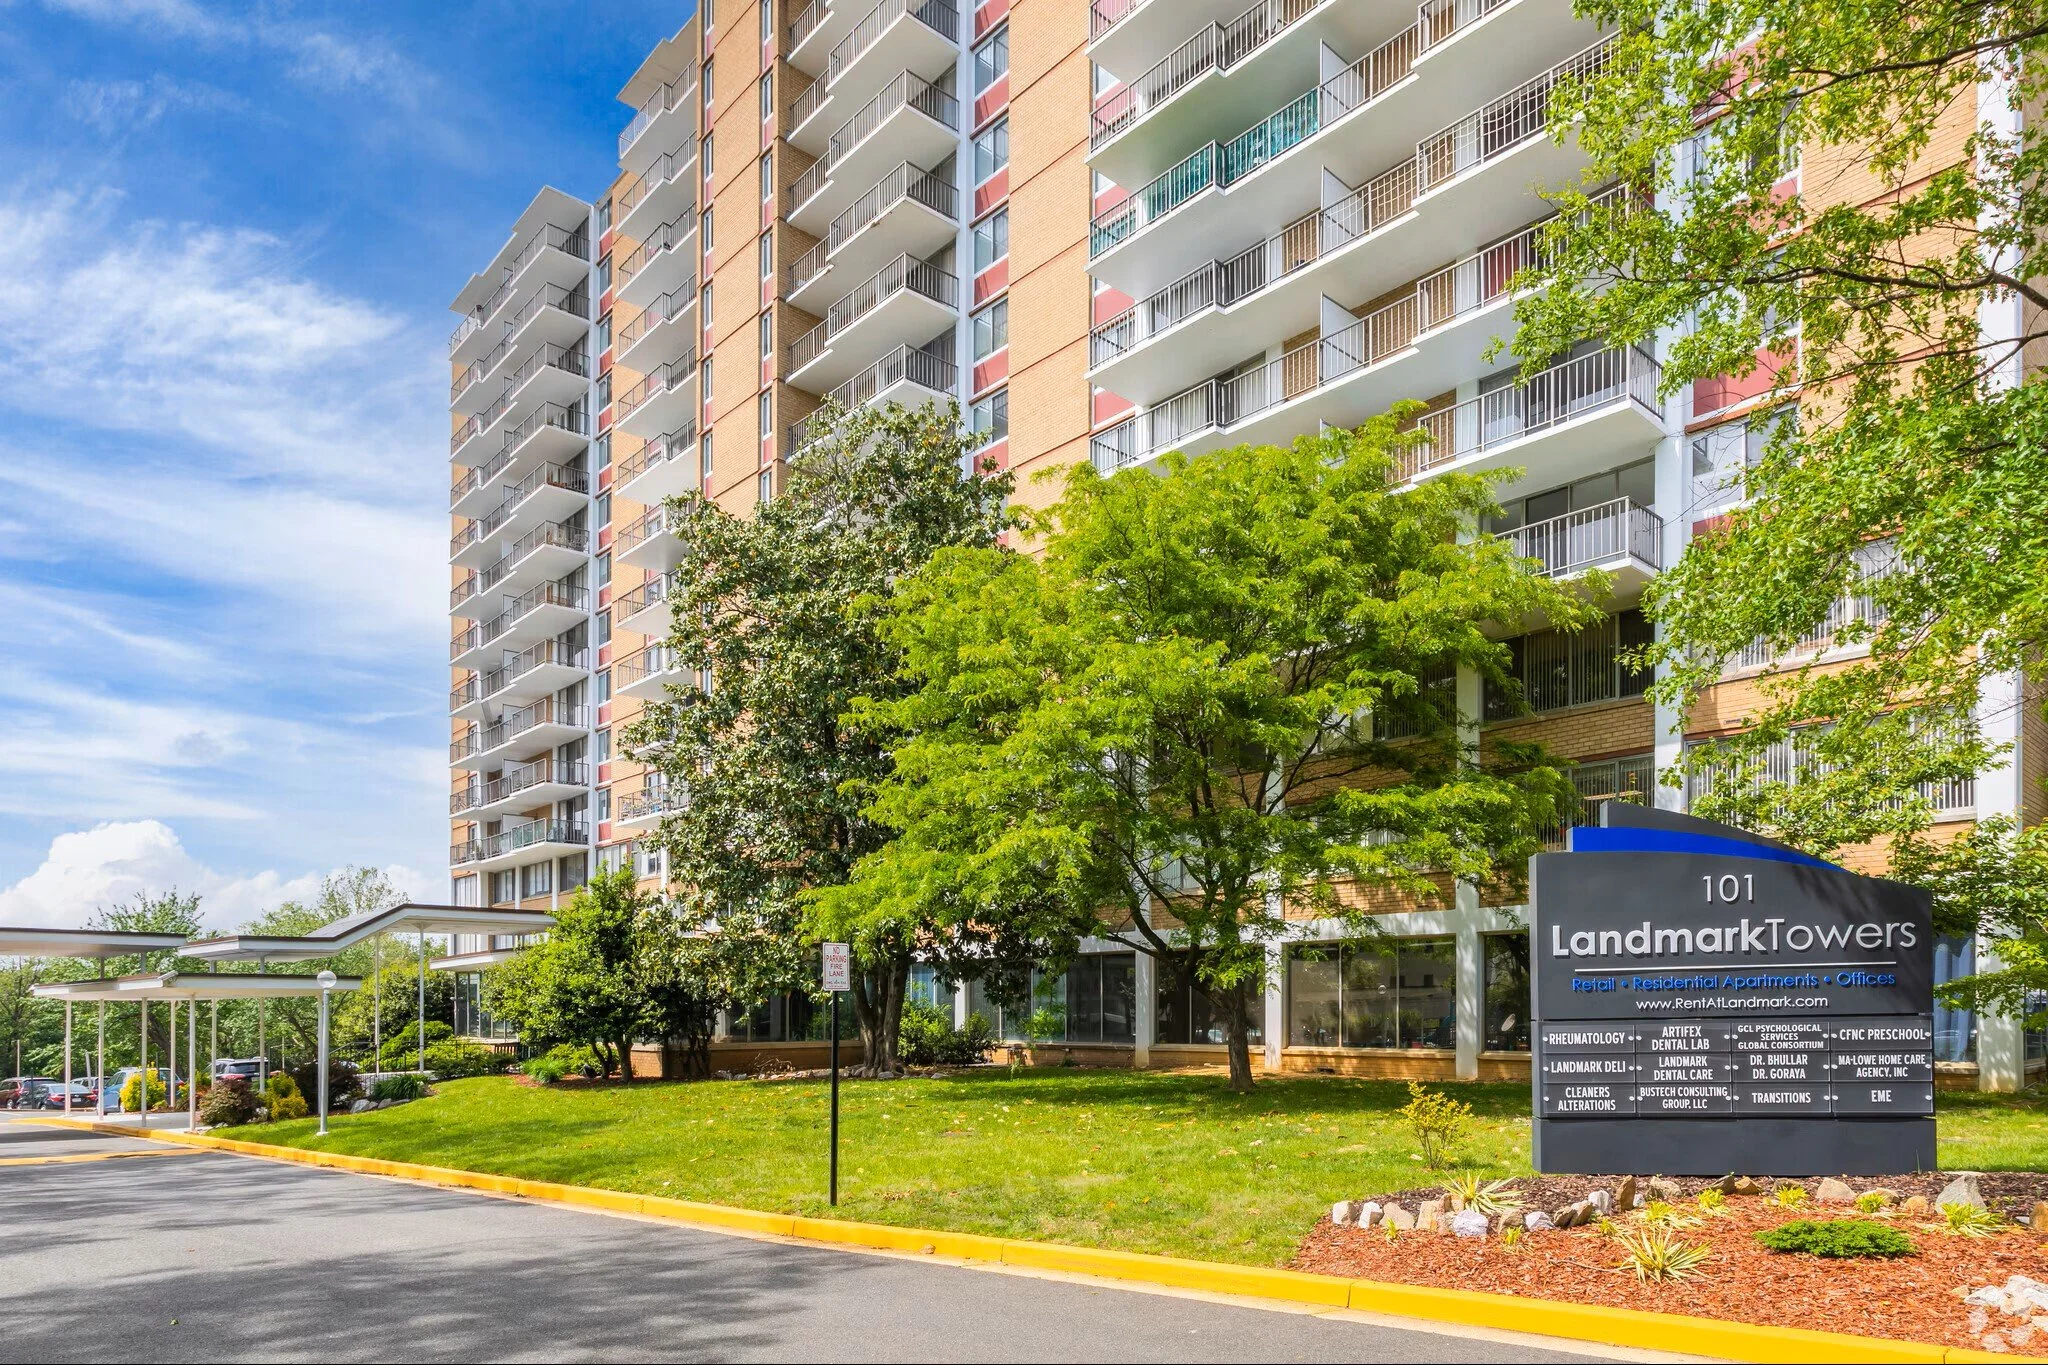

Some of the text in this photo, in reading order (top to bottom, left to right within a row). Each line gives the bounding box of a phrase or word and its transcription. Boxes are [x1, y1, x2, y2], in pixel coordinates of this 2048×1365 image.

[1703, 874, 1754, 903] 101
[1552, 918, 1917, 958] LandmarkTowers
[1572, 971, 1896, 992] Retail Residential Apartments Offices
[1636, 995, 1828, 1010] www.RentAtLandmark.com
[1662, 1026, 1701, 1037] ARTIFEX
[1738, 1024, 1822, 1033] GCL PSYCHOLOGICAL
[1549, 1032, 1625, 1044] RHEUMATOLOGY
[1761, 1033, 1798, 1041] SERVICES
[1839, 1029, 1926, 1040] CFNC PRESCHOOL
[1652, 1039, 1709, 1050] DENTAL LAB
[1771, 1041, 1823, 1049] CONSORTIUM
[1659, 1056, 1707, 1067] LANDMARK
[1750, 1054, 1807, 1065] DR. BHULLAR
[1838, 1055, 1925, 1065] MA-LOWE HOME CARE
[1551, 1061, 1625, 1073] LANDMARK DELI
[1856, 1067, 1908, 1077] AGENCY, INC
[1654, 1069, 1713, 1081] DENTAL CARE
[1753, 1068, 1805, 1079] DR. GORAYA
[1565, 1087, 1610, 1097] CLEANERS
[1640, 1086, 1727, 1097] BUSTECH CONSULTING
[1871, 1090, 1892, 1102] EME
[1752, 1092, 1811, 1104] TRANSITIONS
[1558, 1099, 1615, 1111] ALTERATIONS
[1663, 1099, 1707, 1109] GROUP, LLC
